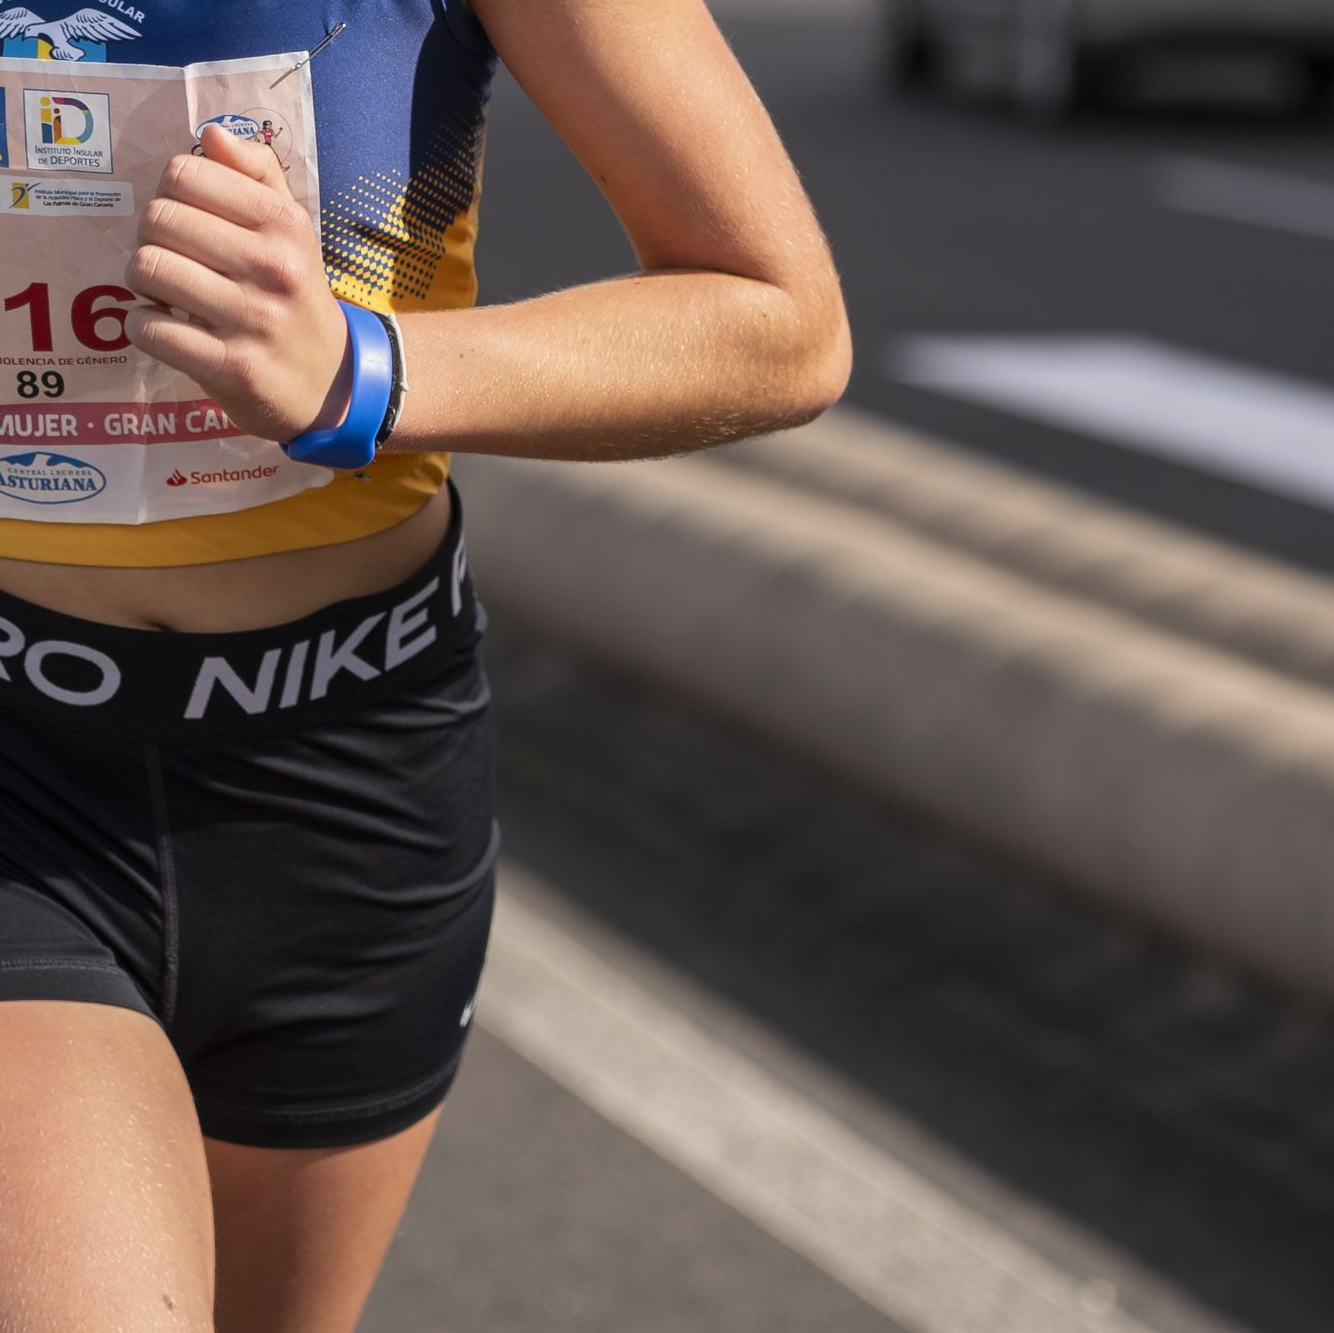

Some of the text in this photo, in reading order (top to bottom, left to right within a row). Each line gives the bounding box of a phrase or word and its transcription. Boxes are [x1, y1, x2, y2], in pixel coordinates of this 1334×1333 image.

[35, 146, 103, 157] INSTITUTO INSULAR
[51, 156, 100, 167] DEPORTES
[59, 356, 73, 366] DE
[77, 355, 127, 365] GÉNERO
[17, 370, 65, 399] 89
[104, 411, 176, 436] GRAN
[7, 467, 47, 476] CENTRAL
[190, 464, 279, 485] Santander
[183, 576, 440, 720] NIKE
